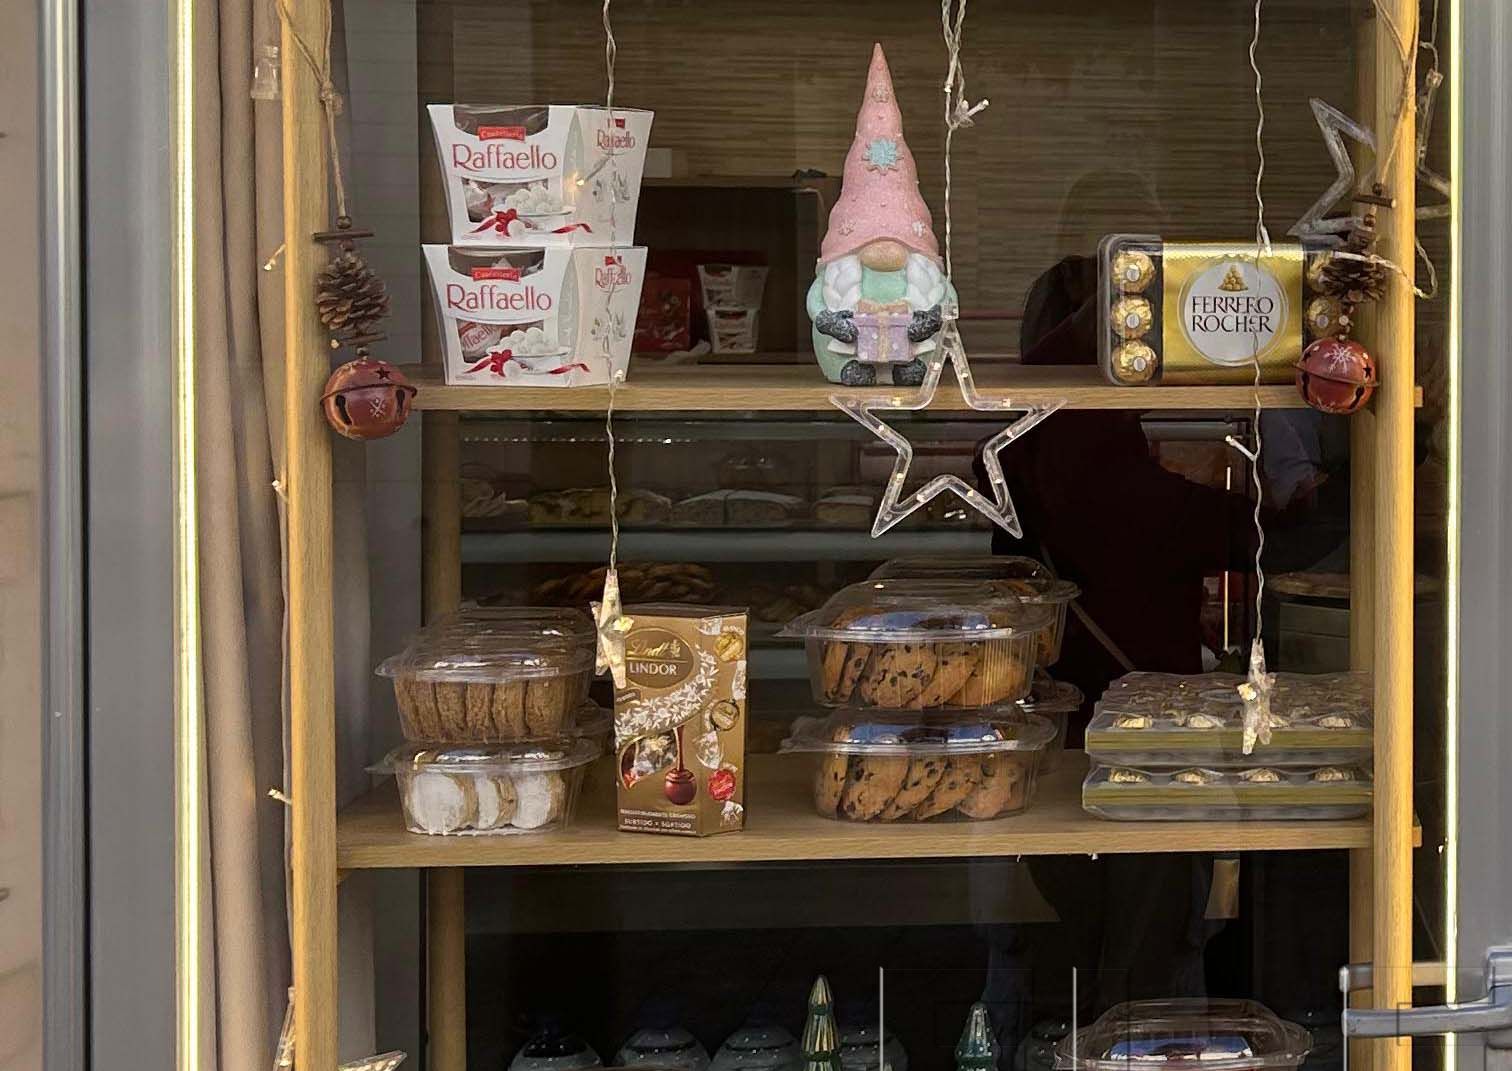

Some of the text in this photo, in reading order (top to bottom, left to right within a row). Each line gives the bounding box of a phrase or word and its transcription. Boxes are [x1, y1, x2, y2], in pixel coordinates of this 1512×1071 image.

[452, 143, 557, 173] Raffaello
[446, 283, 552, 314] Raffaello
[1192, 295, 1274, 314] FERRERO
[1192, 314, 1274, 334] ROCHER
[626, 639, 670, 657] Lindt
[629, 661, 678, 676] LINDOR
